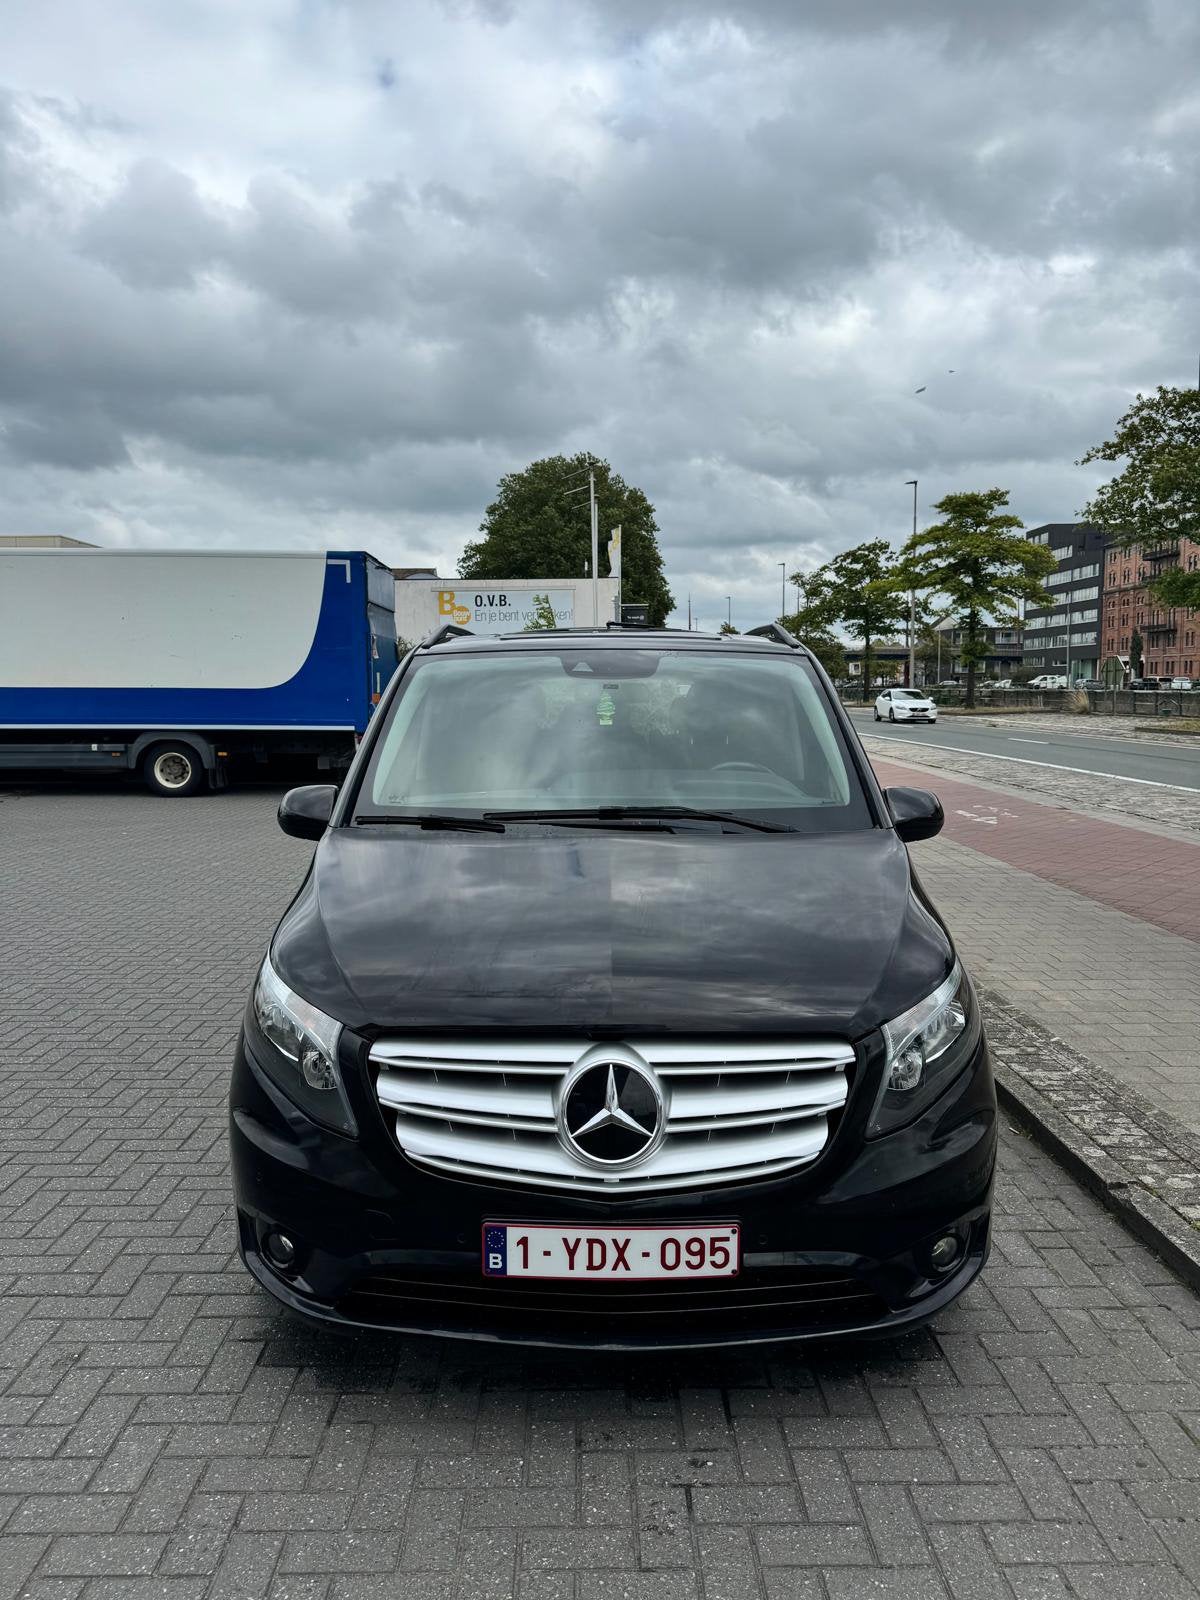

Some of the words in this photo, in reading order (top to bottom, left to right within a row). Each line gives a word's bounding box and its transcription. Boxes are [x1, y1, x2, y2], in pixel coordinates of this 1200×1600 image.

[474, 594, 511, 607] O.V.B.
[474, 609, 487, 621] En
[488, 609, 497, 624] je
[498, 609, 519, 621] bent
[521, 609, 573, 621] verken!
[489, 1253, 502, 1269] B
